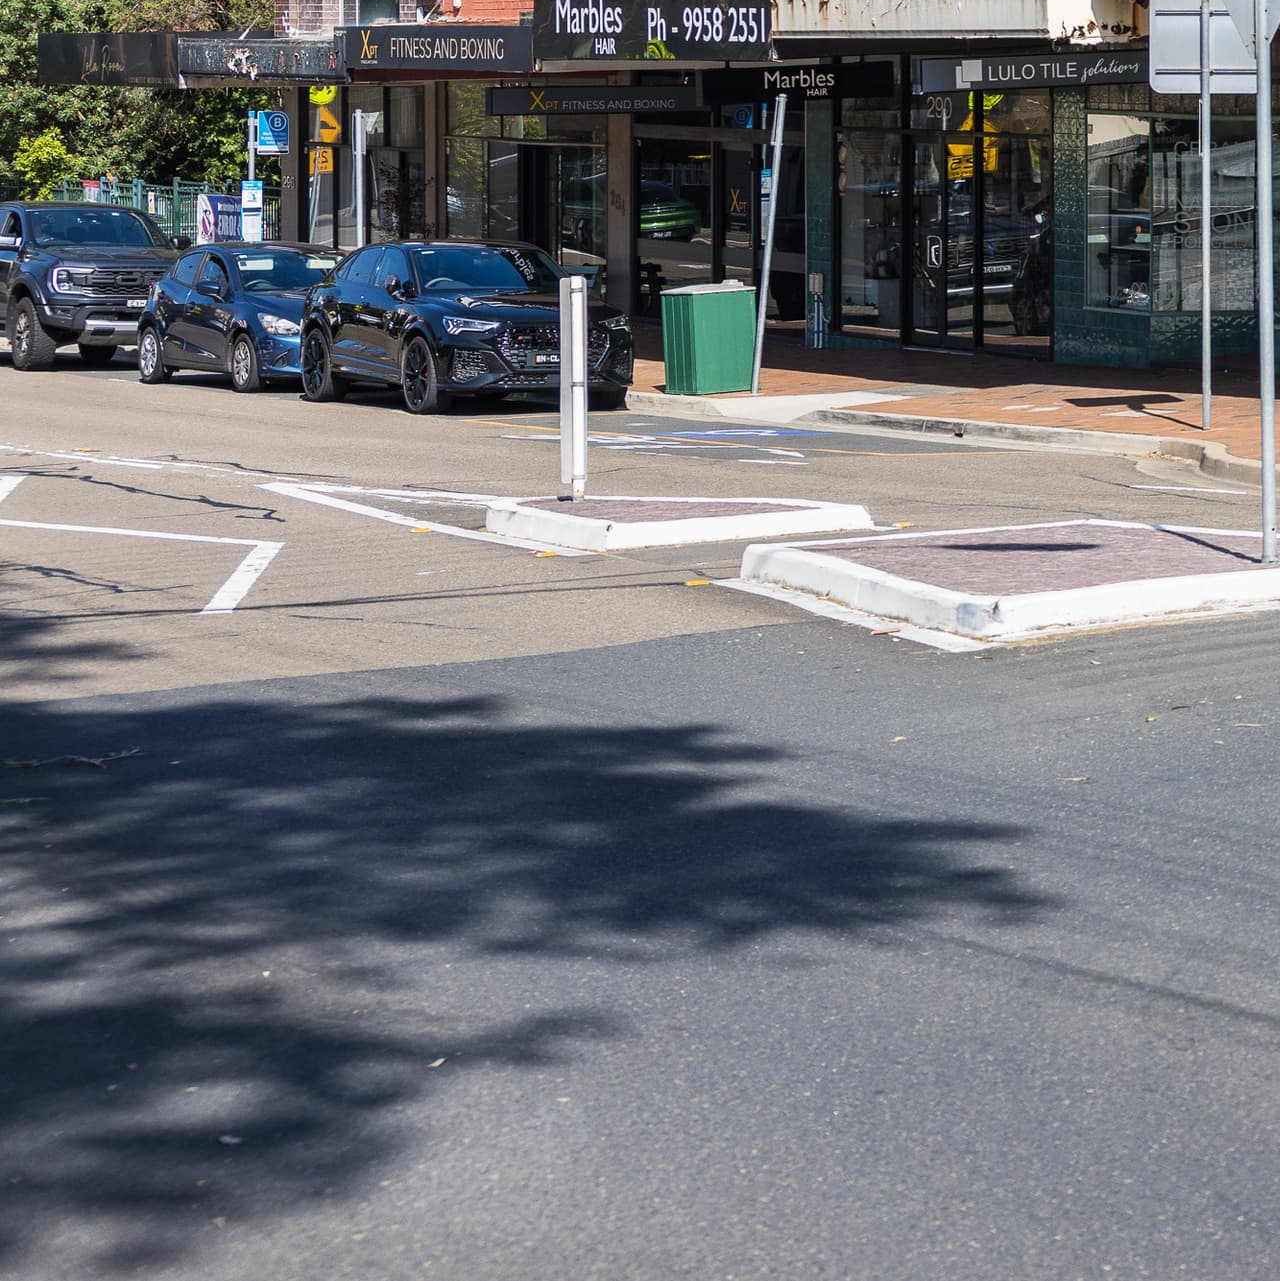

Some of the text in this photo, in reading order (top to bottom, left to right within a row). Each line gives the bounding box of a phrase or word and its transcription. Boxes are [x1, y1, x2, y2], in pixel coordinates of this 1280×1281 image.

[647, 7, 667, 41] Ph
[683, 7, 723, 42] 9958
[727, 7, 766, 43] 2551
[390, 37, 504, 60] FITNESS AND BOXING
[595, 37, 617, 55] HAIR
[763, 68, 835, 89] Marbles
[988, 57, 1141, 83] LULO TILE solutions
[806, 88, 828, 97] HAIR
[562, 98, 676, 111] FITNESS AND BOXING
